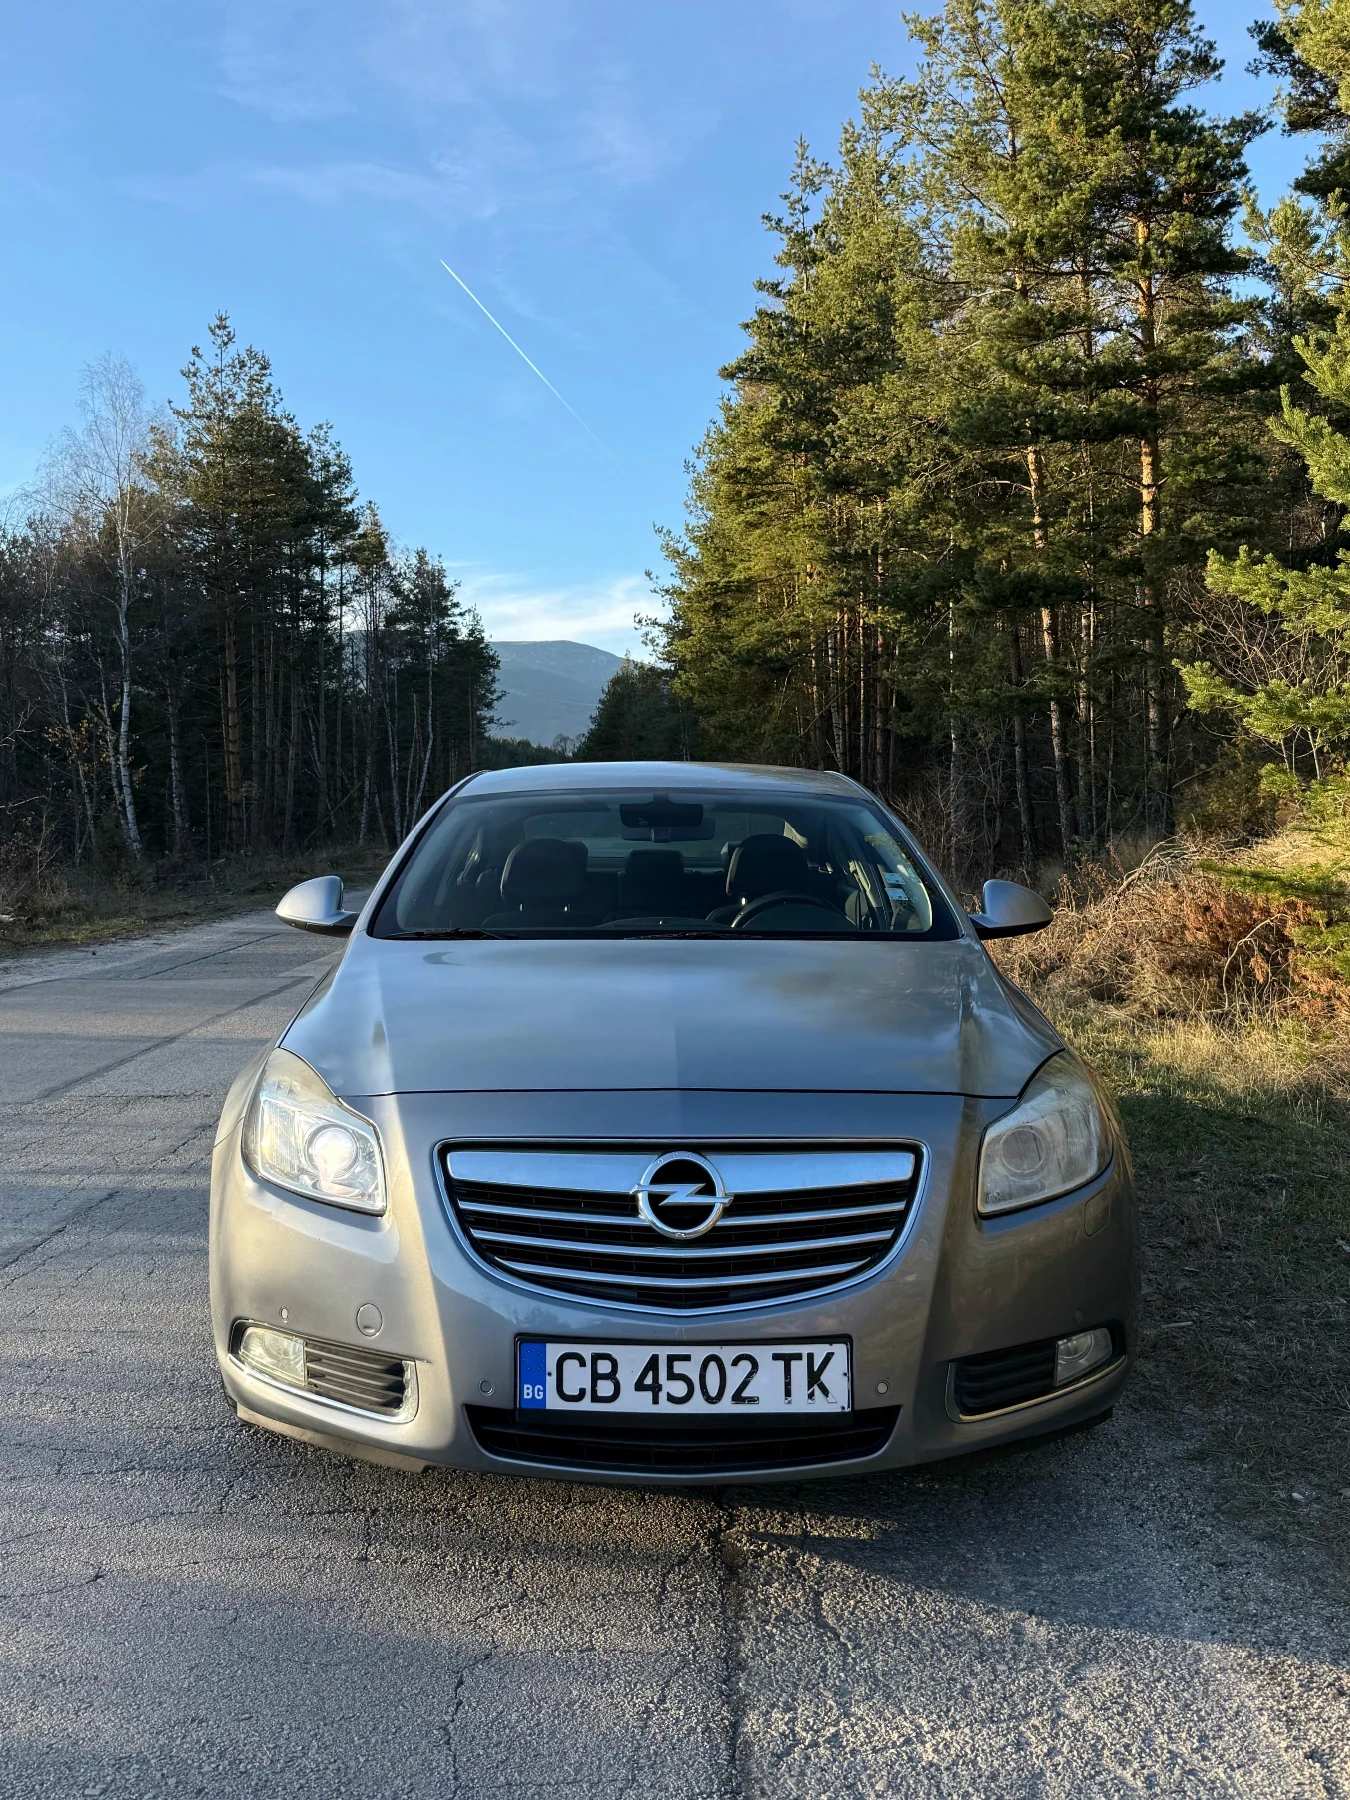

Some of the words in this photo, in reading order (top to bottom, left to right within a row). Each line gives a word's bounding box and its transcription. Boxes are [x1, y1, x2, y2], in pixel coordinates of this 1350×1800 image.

[523, 1384, 544, 1400] BG
[555, 1352, 621, 1404] CB
[634, 1353, 760, 1405] 4502
[772, 1352, 838, 1405] TK
